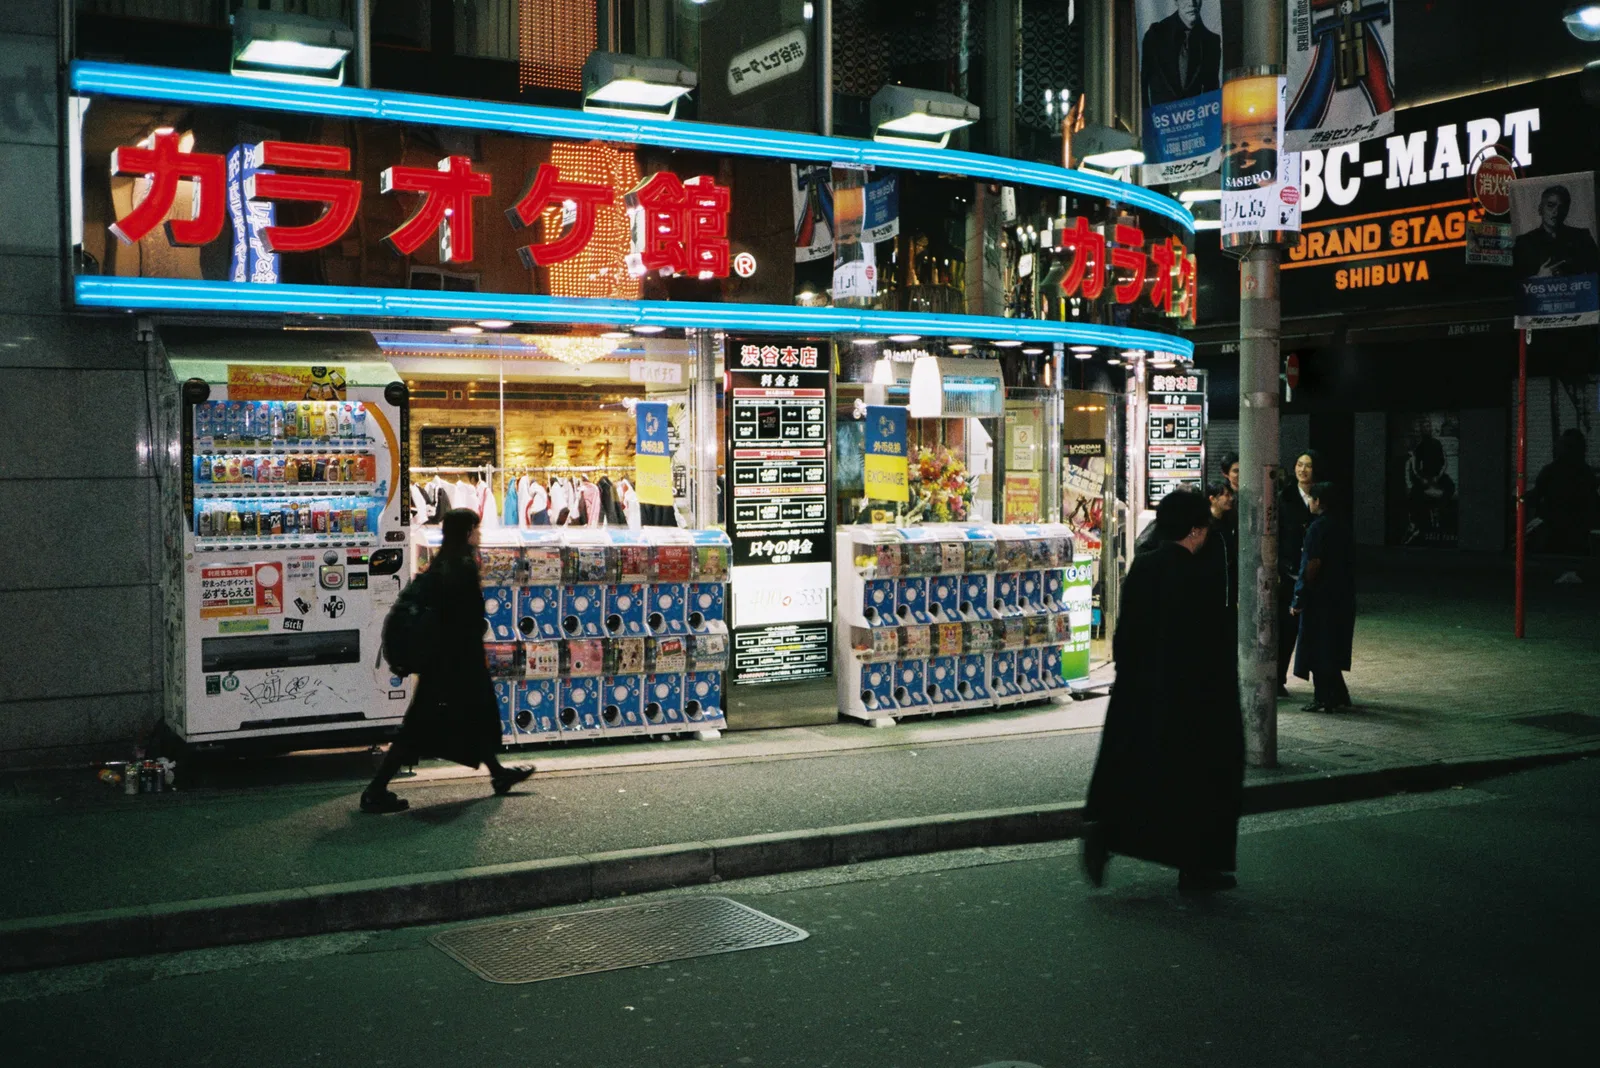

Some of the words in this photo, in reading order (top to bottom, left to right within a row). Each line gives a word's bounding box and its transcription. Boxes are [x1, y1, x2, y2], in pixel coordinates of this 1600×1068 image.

[1152, 112, 1170, 128] es
[1172, 108, 1195, 126] we
[1197, 101, 1220, 119] are
[1225, 170, 1272, 187] SASEBO
[107, 128, 731, 279] カラオケ館
[1289, 223, 1381, 261] GRAND
[1335, 260, 1430, 291] SHIBUYA
[1523, 283, 1545, 295] Yes
[1547, 281, 1567, 293] we
[1570, 279, 1591, 291] are
[740, 344, 818, 367] 渋谷本店
[866, 469, 905, 487] EXCHANGE
[748, 538, 814, 557] 只今の料金
[202, 579, 254, 588] 貯まったポイントで
[202, 587, 254, 600] 必ずもらえる!
